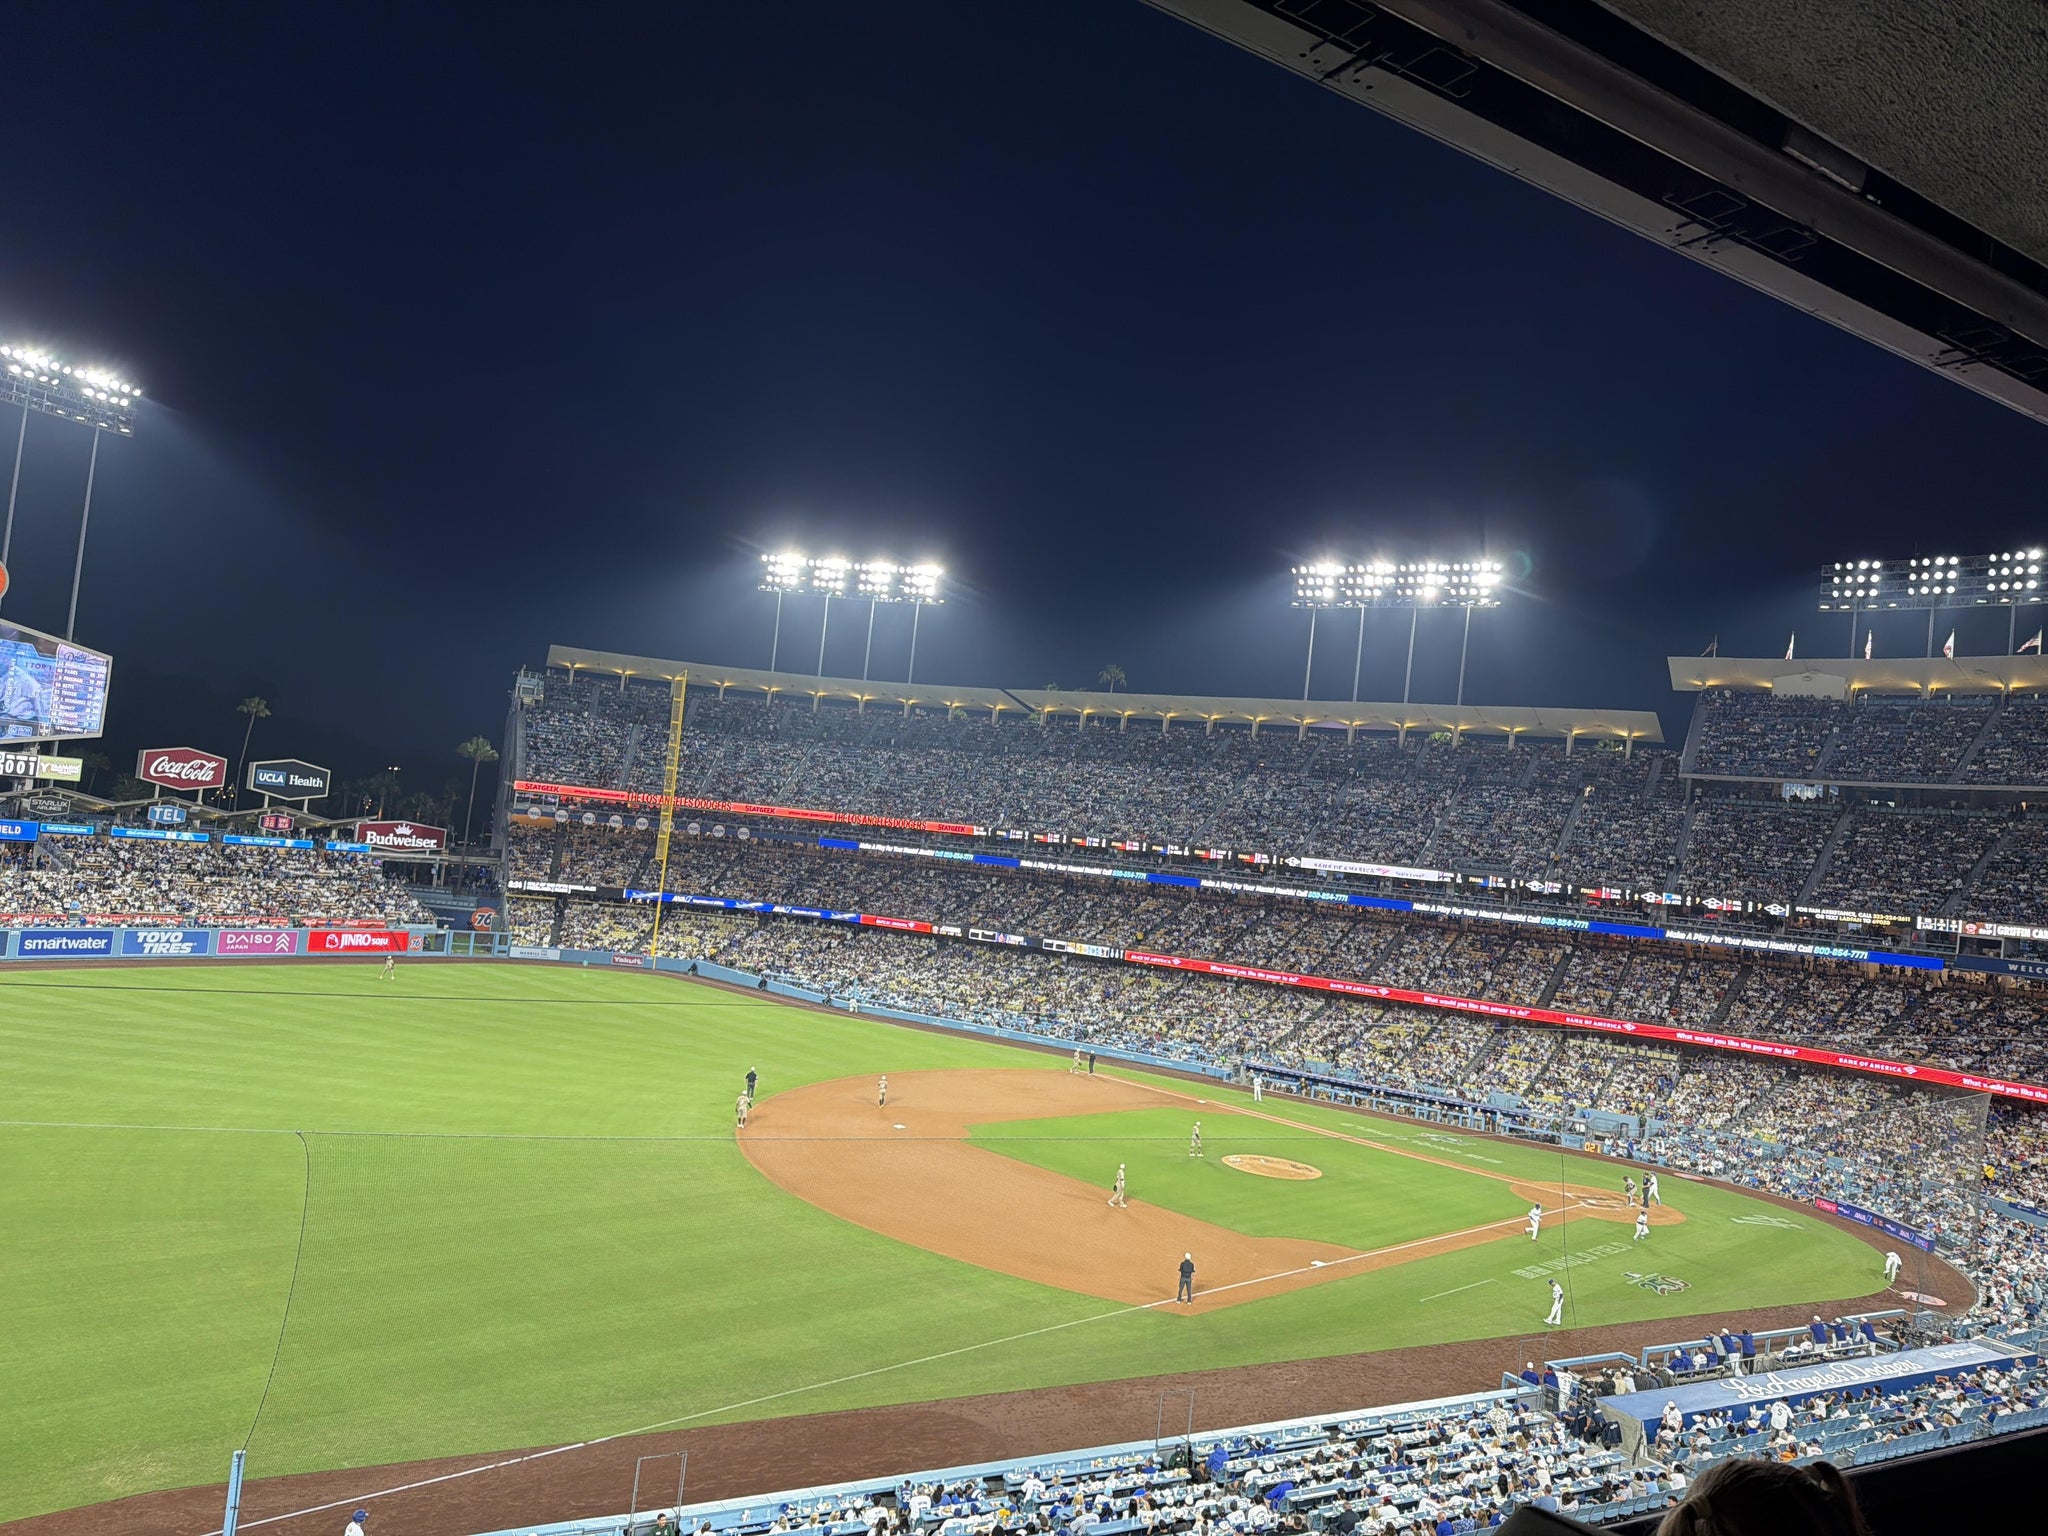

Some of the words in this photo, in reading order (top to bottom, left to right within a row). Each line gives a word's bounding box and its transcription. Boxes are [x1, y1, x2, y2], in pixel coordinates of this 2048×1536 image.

[150, 756, 219, 782] Coca-Cola
[259, 772, 284, 784] UCLA
[289, 774, 323, 788] Health
[154, 808, 181, 821] TEL
[476, 912, 495, 926] 76
[1412, 903, 1430, 911] Make
[1437, 905, 1451, 915] Play
[1463, 908, 1478, 917] Your
[1479, 910, 1502, 919] Mental
[1527, 916, 1541, 924] Call
[24, 937, 108, 950] smartwater
[137, 932, 183, 943] TOYO
[227, 934, 272, 944] DAISO
[339, 934, 370, 949] JINRO
[143, 943, 192, 953] TIRES
[1666, 930, 1686, 939] Make
[1686, 932, 1693, 940] A
[1693, 933, 1709, 943] Play
[1711, 935, 1723, 944] For
[1724, 937, 1741, 945] Your
[1742, 938, 1768, 949] Mental
[1798, 944, 1813, 954] Call
[1814, 946, 1868, 959] 800-854-7771
[614, 956, 642, 965] Yakult
[1593, 1021, 1622, 1029] AMERICA
[1753, 1044, 1773, 1052] power
[1870, 1062, 1902, 1073] AMERICA
[1963, 1078, 1981, 1087] What
[2006, 1084, 2019, 1095] you
[2020, 1087, 2034, 1097] like
[2035, 1089, 2047, 1099] the
[1720, 1378, 1774, 1399] Los
[1767, 1372, 1843, 1394] Angeles
[1829, 1358, 1924, 1384] Dodgers
